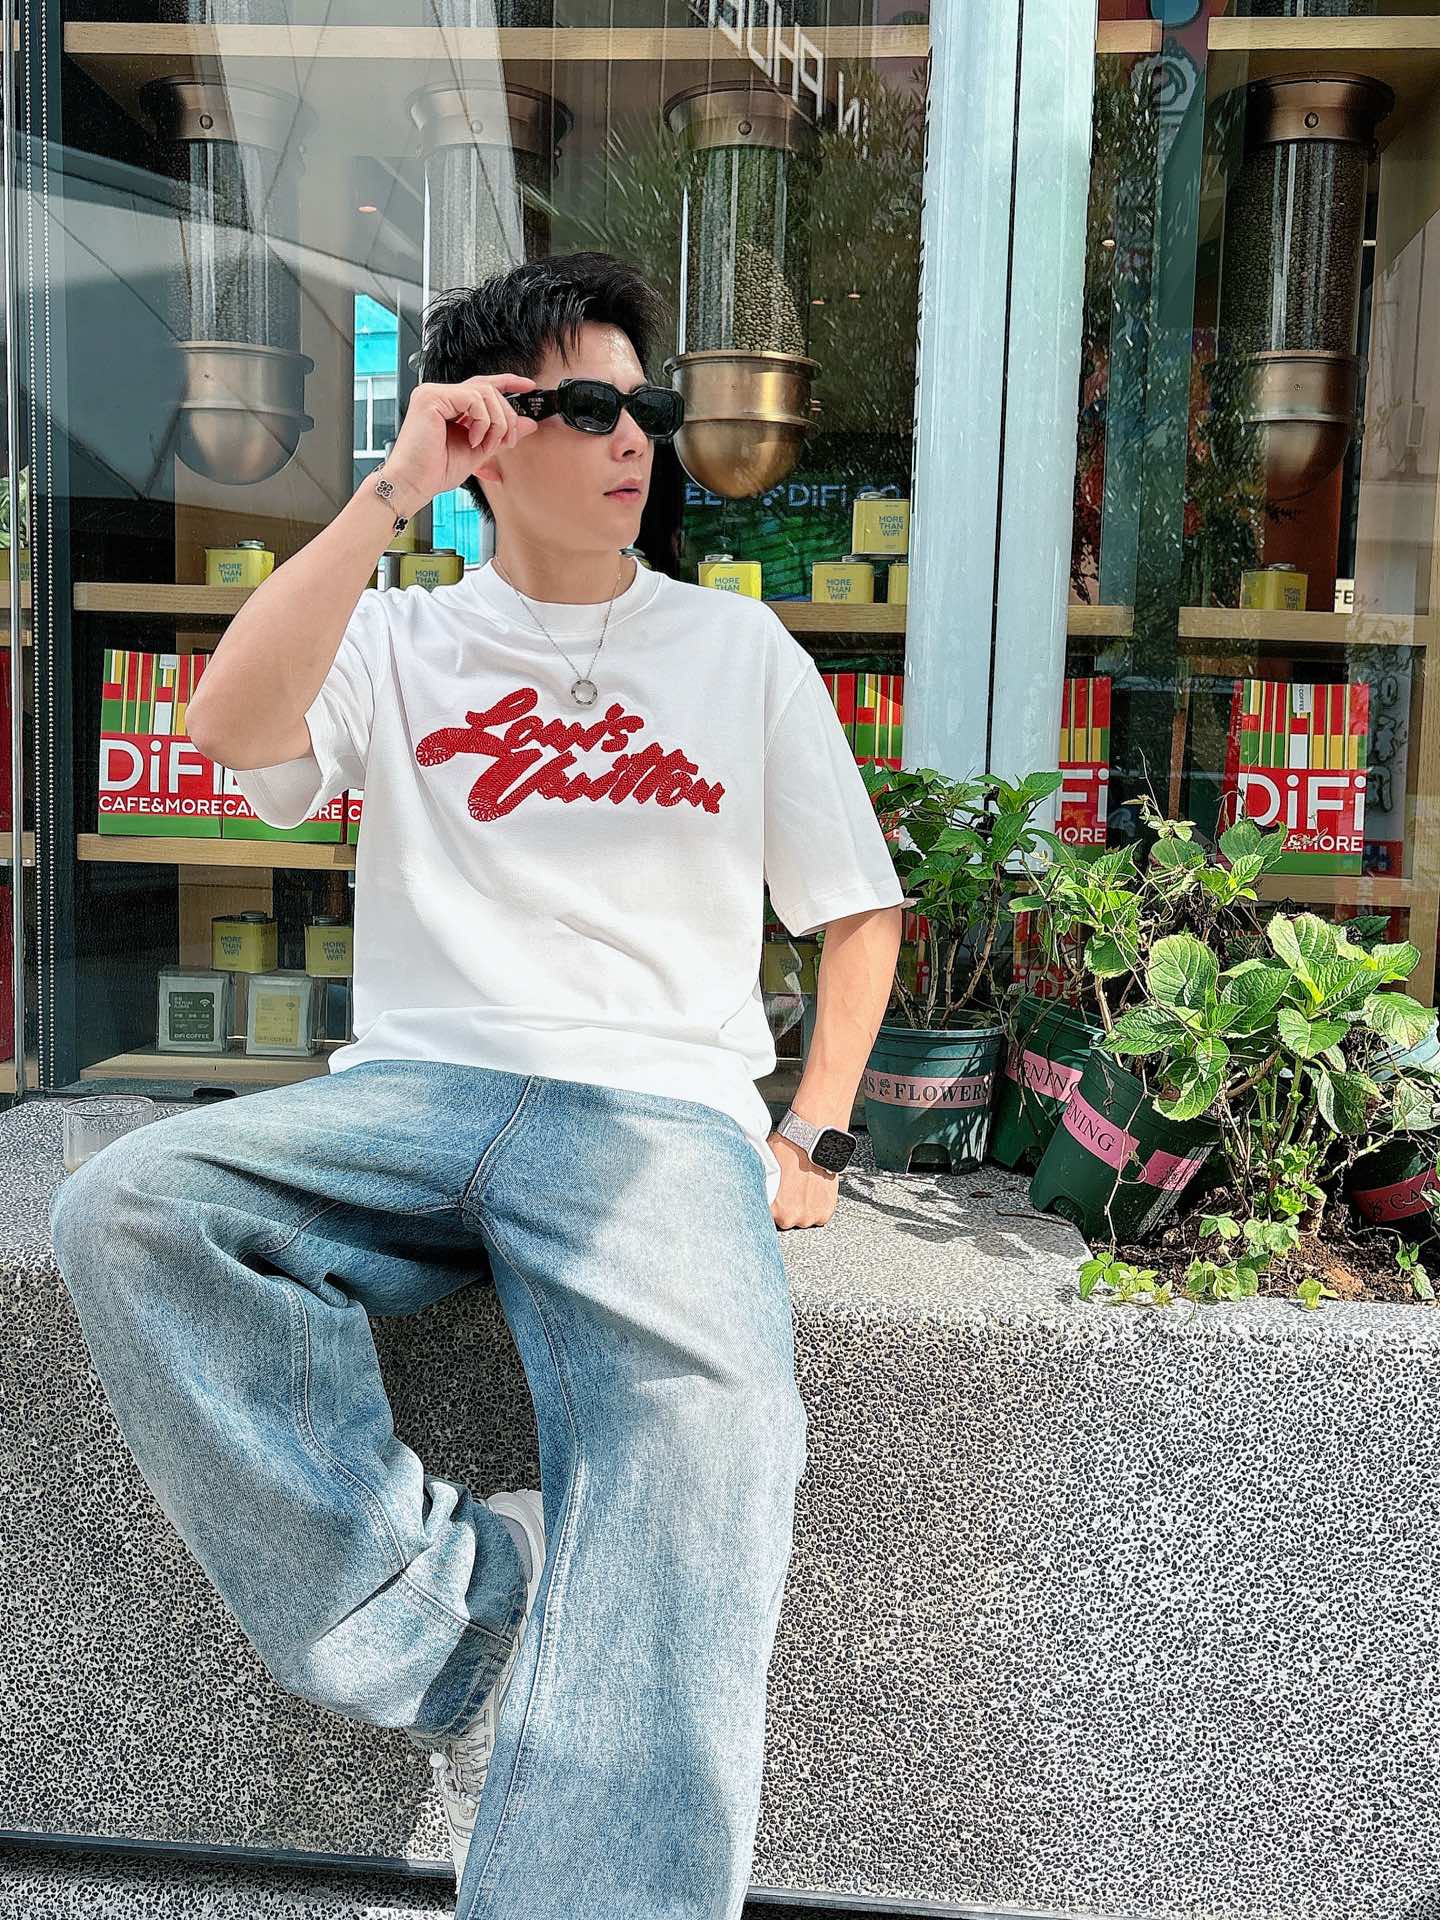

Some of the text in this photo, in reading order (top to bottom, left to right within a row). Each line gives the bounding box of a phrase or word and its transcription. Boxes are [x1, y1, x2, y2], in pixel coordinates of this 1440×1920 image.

[879, 515, 904, 523] MORE
[415, 570, 439, 578] MORE
[826, 578, 852, 586] MORE
[416, 687, 645, 767] Louis
[467, 742, 726, 822] Vuitton
[98, 796, 222, 816] CAFE&MORE
[1236, 772, 1367, 831] DiFi
